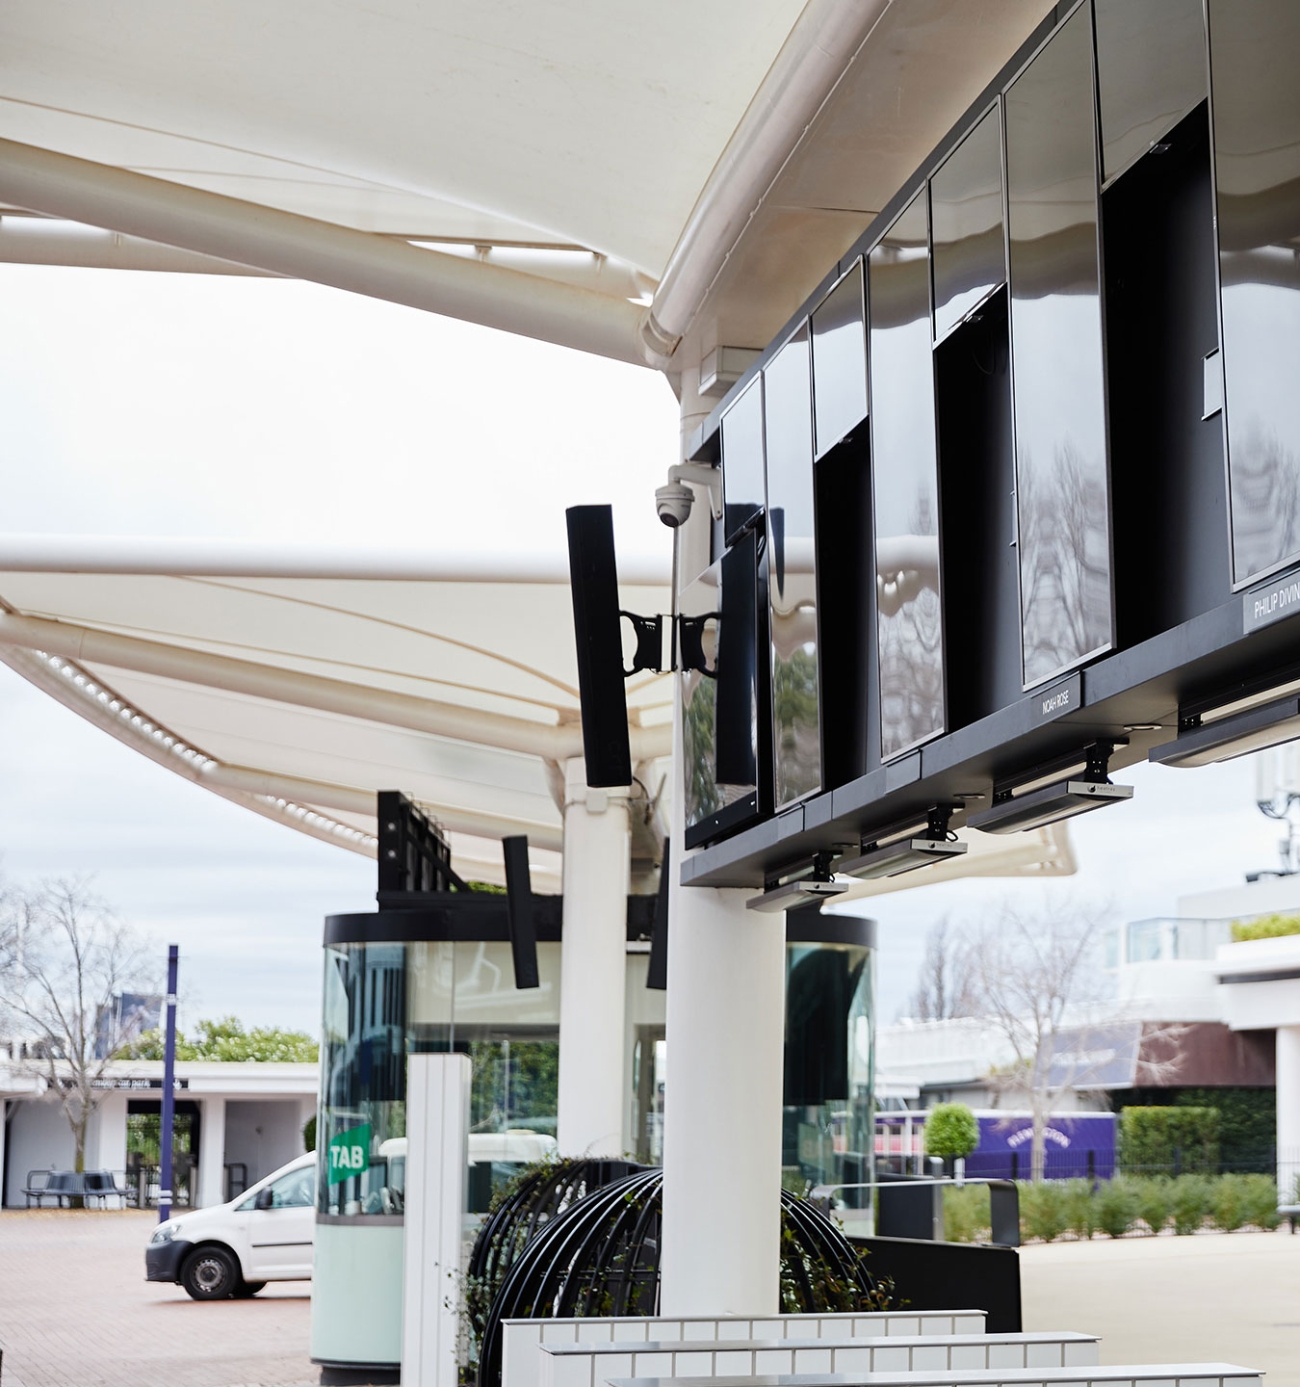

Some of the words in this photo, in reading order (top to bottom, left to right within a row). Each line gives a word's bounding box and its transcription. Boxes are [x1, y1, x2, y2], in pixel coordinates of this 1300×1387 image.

[1254, 592, 1278, 619] PHILIP
[1042, 697, 1057, 715] NOAH
[1056, 689, 1069, 708] ROSE
[330, 1145, 364, 1169] TAB
